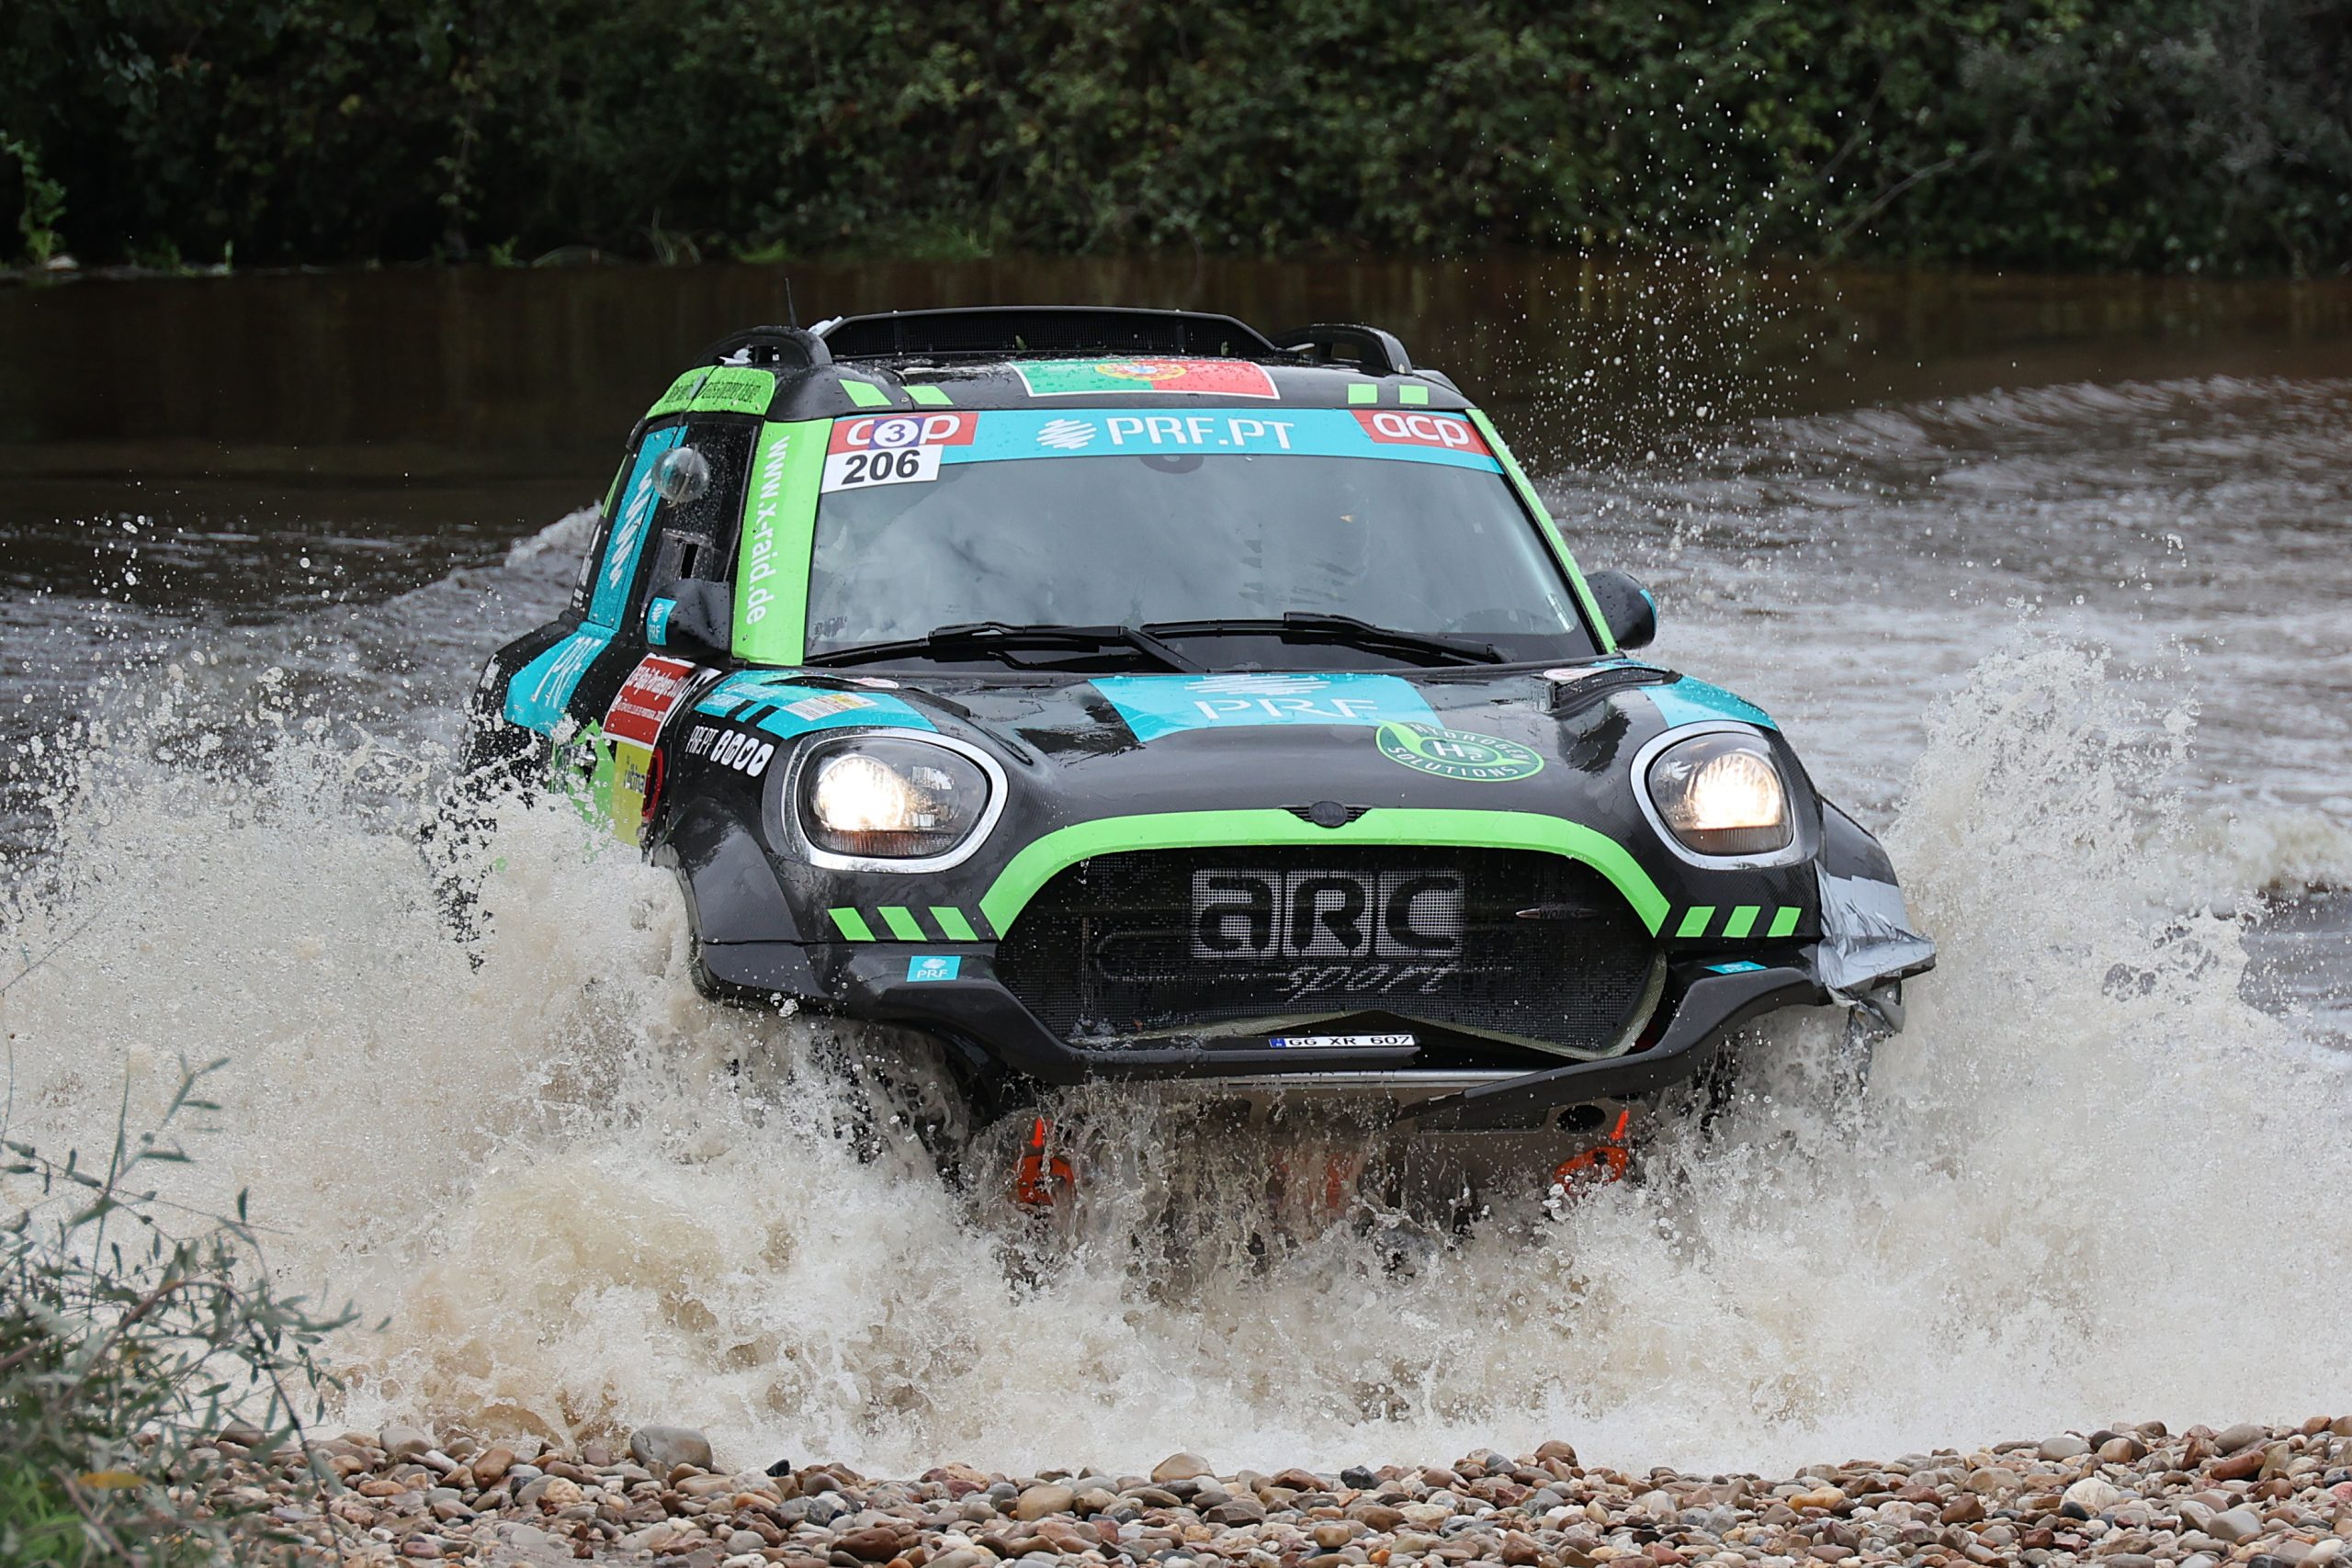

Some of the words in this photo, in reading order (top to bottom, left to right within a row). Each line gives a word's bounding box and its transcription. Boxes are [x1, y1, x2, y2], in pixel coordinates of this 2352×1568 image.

[1105, 416, 1295, 449] PRF.PT
[1372, 413, 1470, 447] acp
[841, 449, 921, 486] 206
[746, 435, 791, 626] www.x-raid.de
[1194, 698, 1379, 720] PRF
[1409, 723, 1531, 761] HYDROGEN
[1387, 746, 1519, 778] SOLUTIONS
[916, 969, 948, 979] PRF
[1289, 1038, 1317, 1046] GG
[1329, 1037, 1357, 1045] XR
[1371, 1036, 1410, 1045] 607
